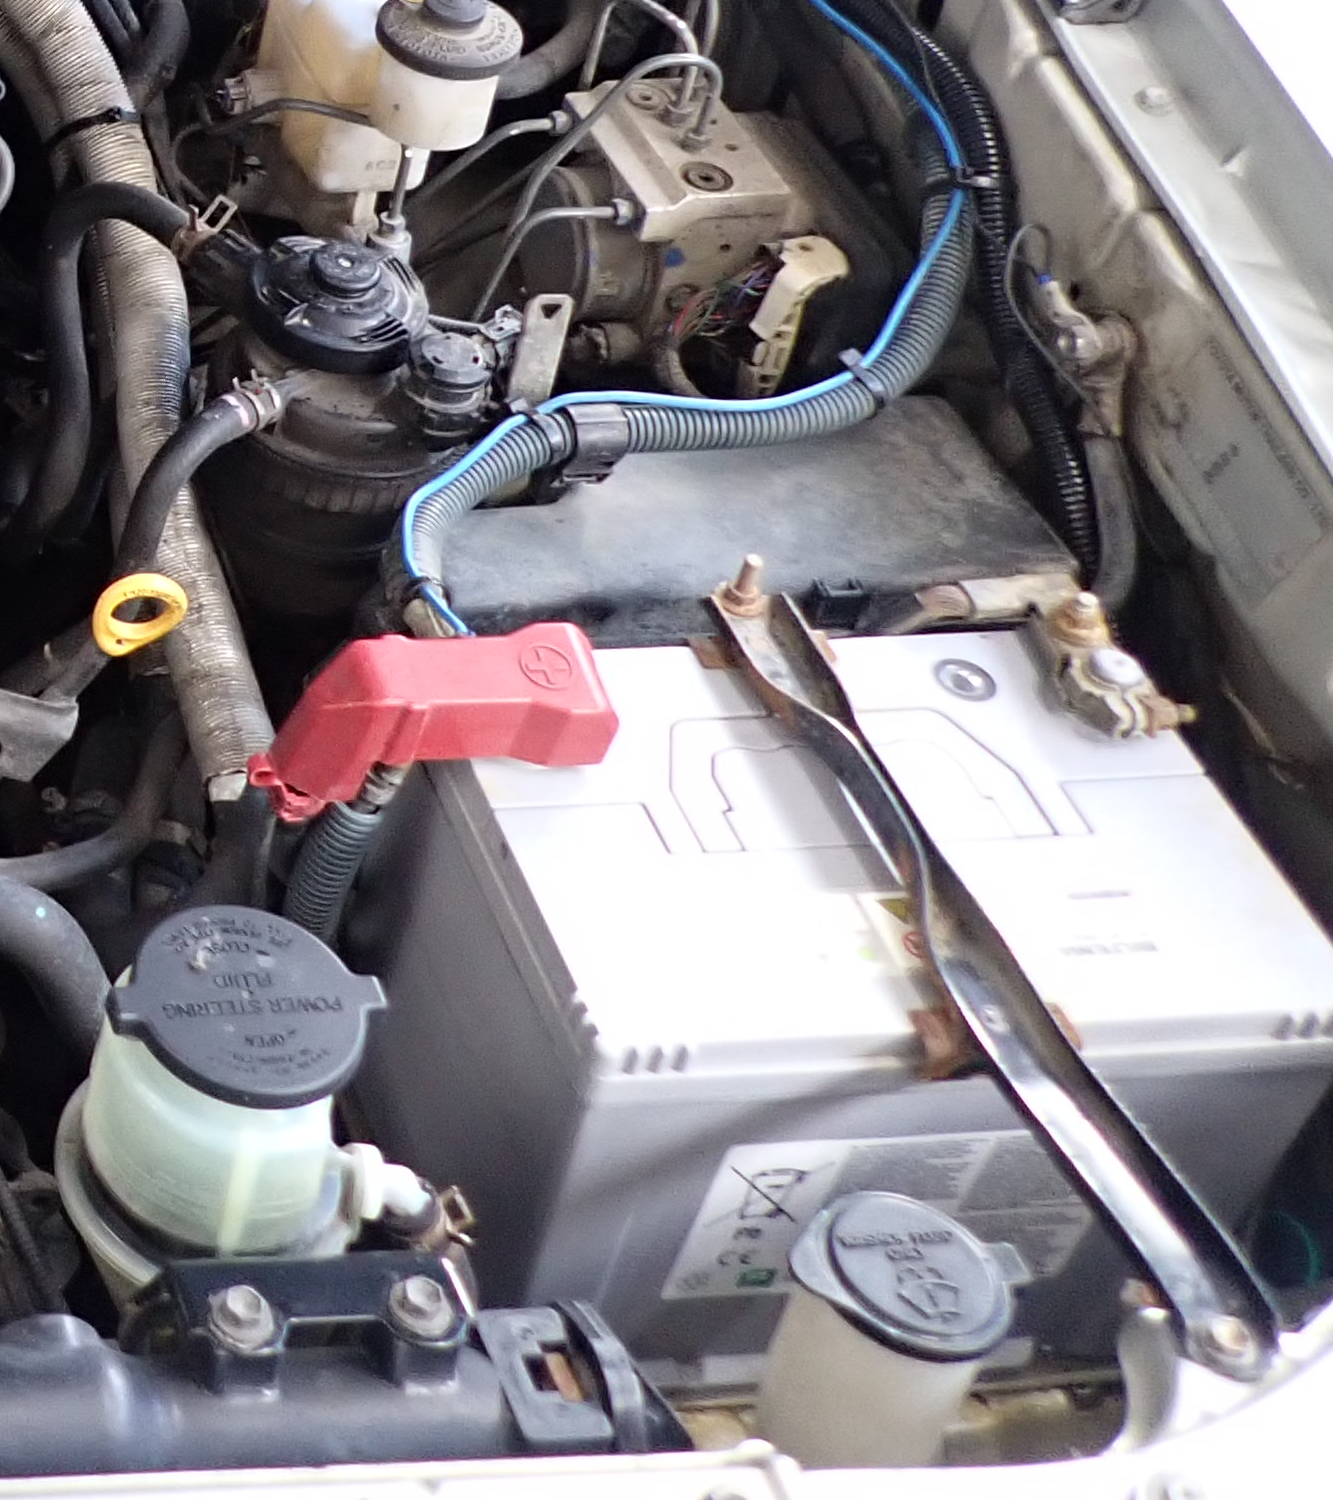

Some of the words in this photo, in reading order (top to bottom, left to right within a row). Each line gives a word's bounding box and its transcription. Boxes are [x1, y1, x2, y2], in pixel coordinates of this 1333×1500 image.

[213, 971, 273, 989] FLUID
[162, 999, 265, 1020] STEERING
[270, 996, 343, 1015] POWER
